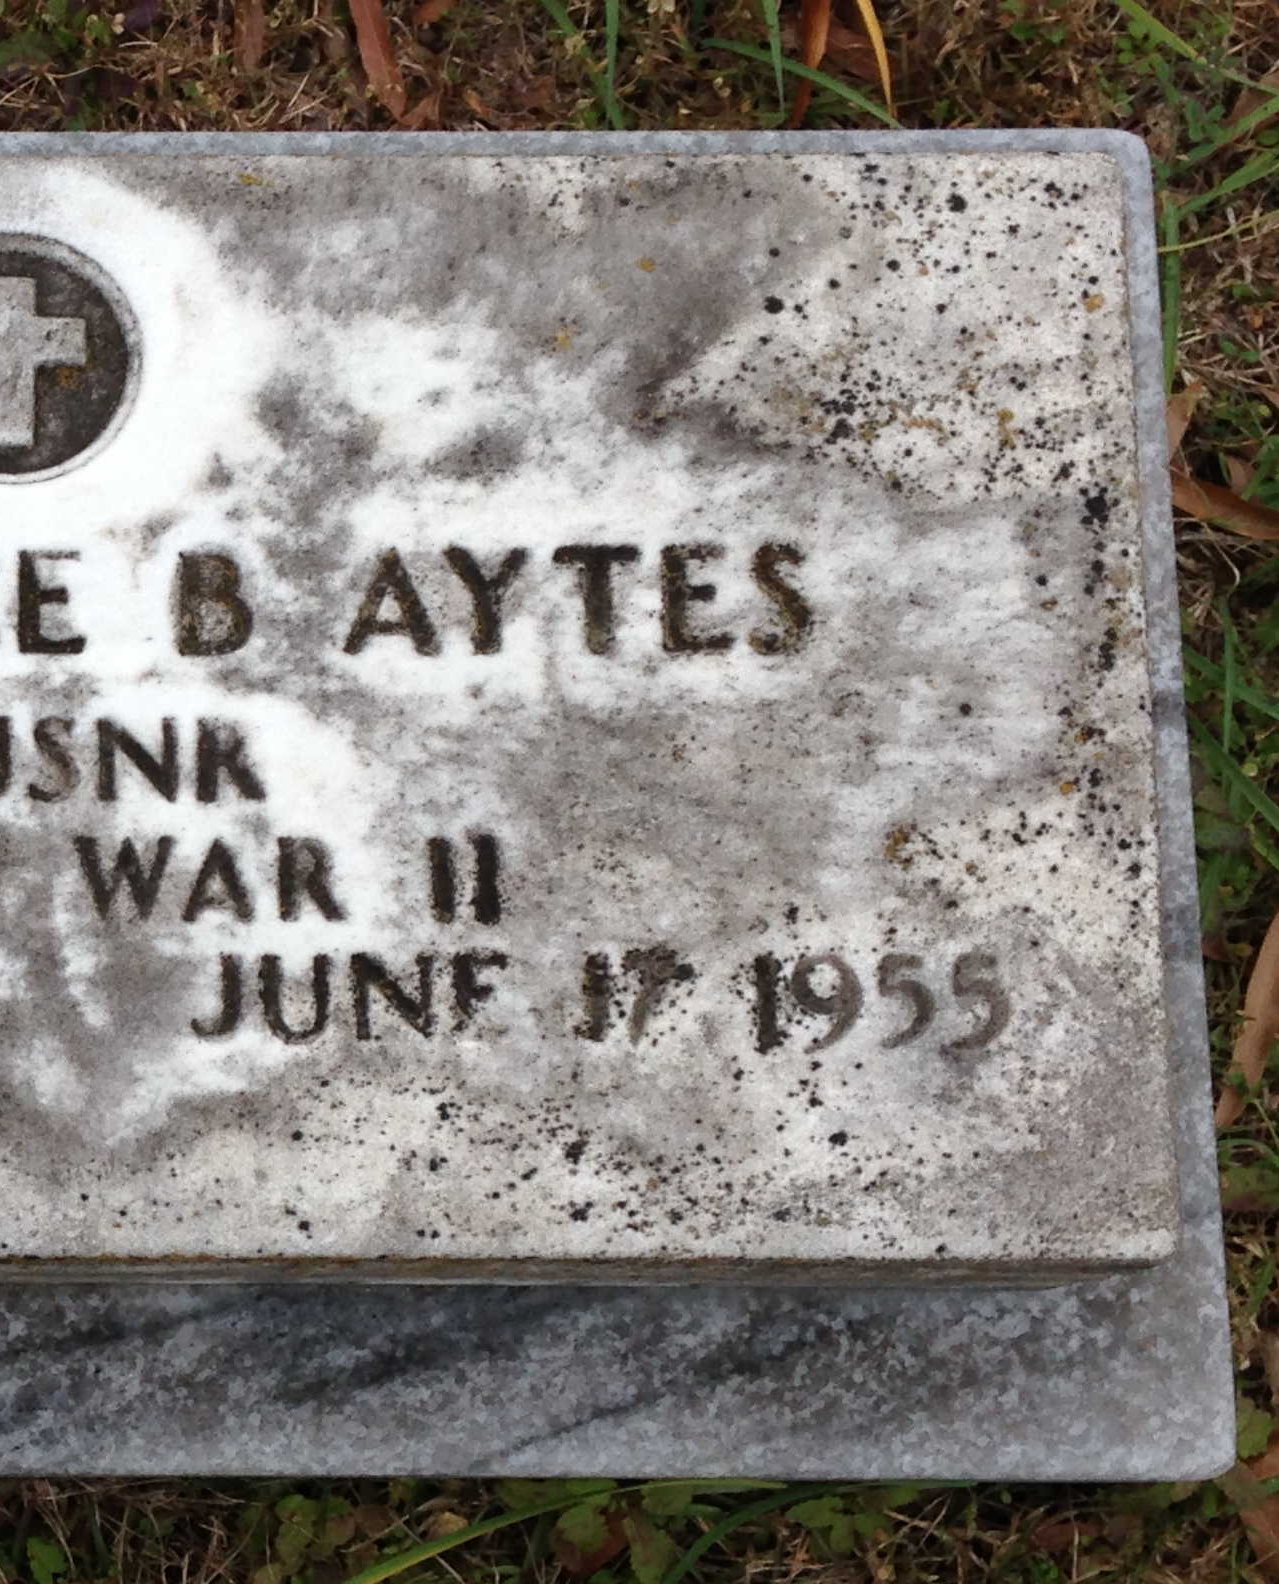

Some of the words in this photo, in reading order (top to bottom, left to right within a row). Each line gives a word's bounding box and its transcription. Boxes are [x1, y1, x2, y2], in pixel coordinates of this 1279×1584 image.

[174, 549, 255, 657] B
[342, 541, 815, 657] AYTES
[72, 833, 347, 924] WAR
[425, 831, 502, 926] II
[190, 948, 508, 1045] JUNE
[574, 944, 696, 1045] 17
[752, 951, 1012, 1064] 1955
